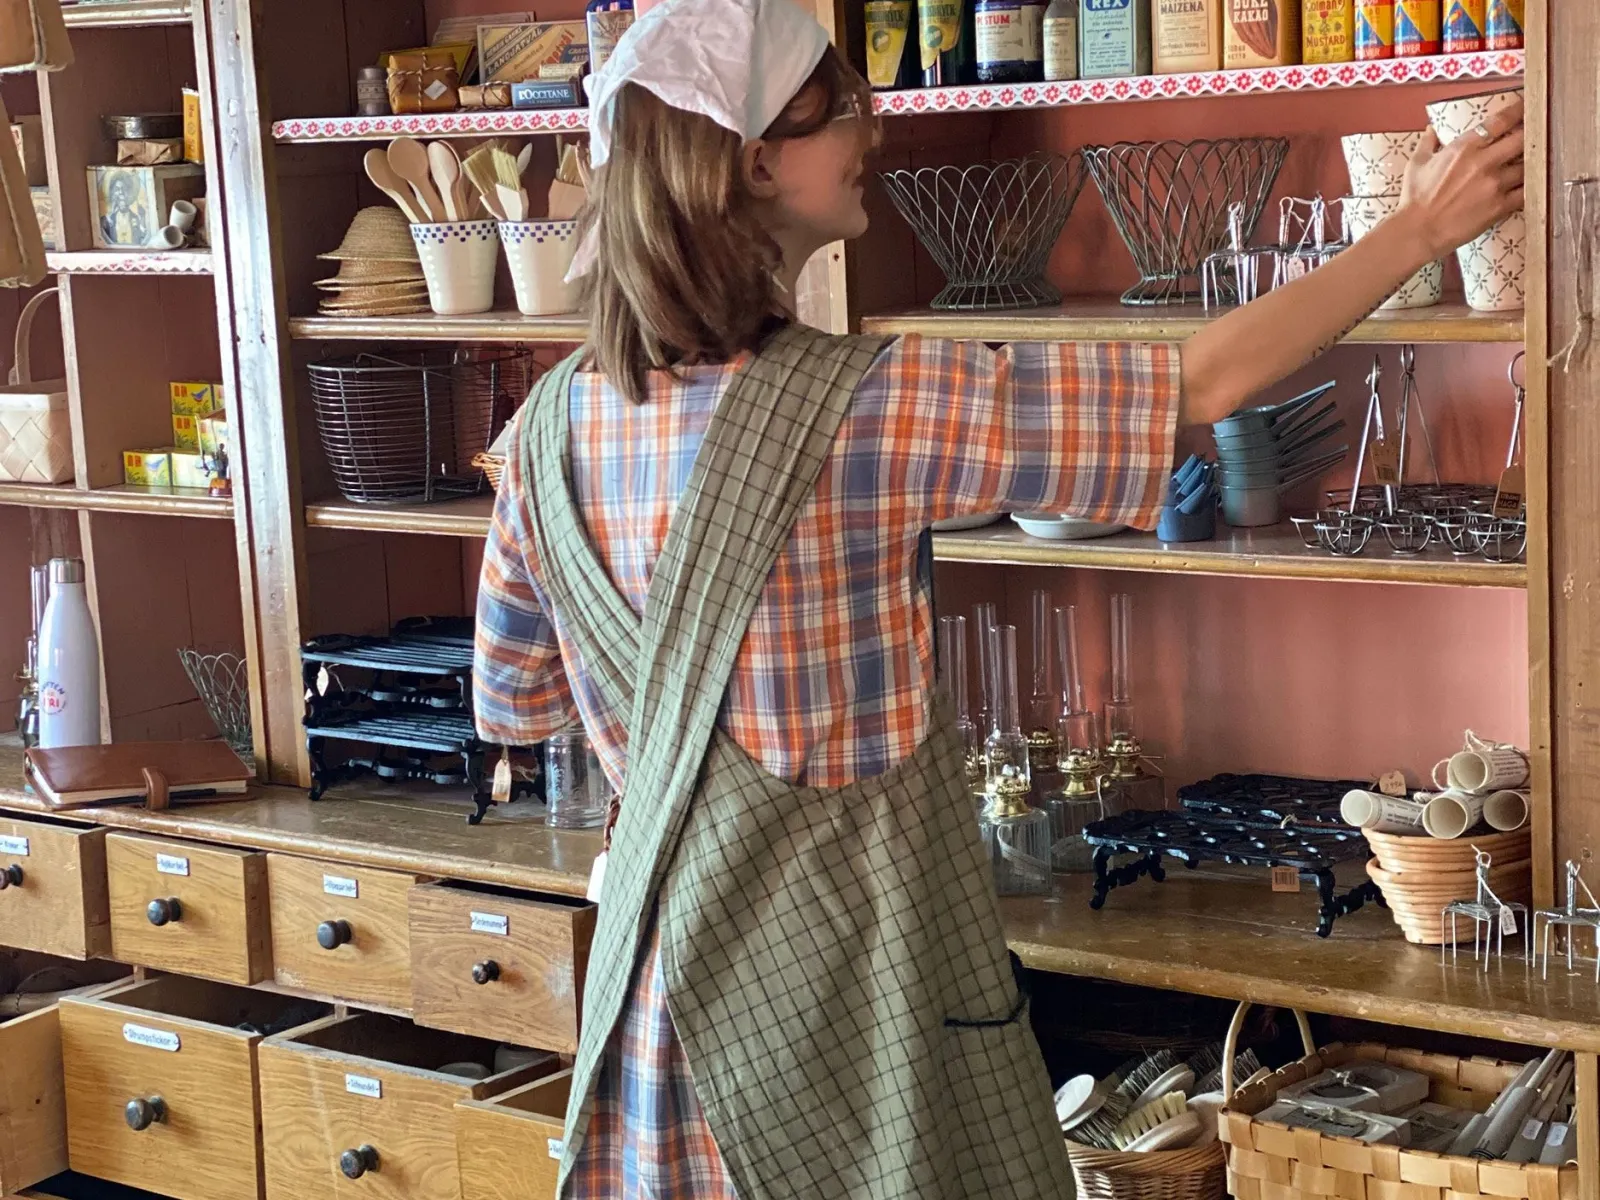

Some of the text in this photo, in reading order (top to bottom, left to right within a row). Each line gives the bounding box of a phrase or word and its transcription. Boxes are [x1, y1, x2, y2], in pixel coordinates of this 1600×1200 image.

[1160, 1, 1204, 15] MAIZENA
[1233, 9, 1269, 23] KAKAO
[1306, 35, 1346, 48] MUSTARD
